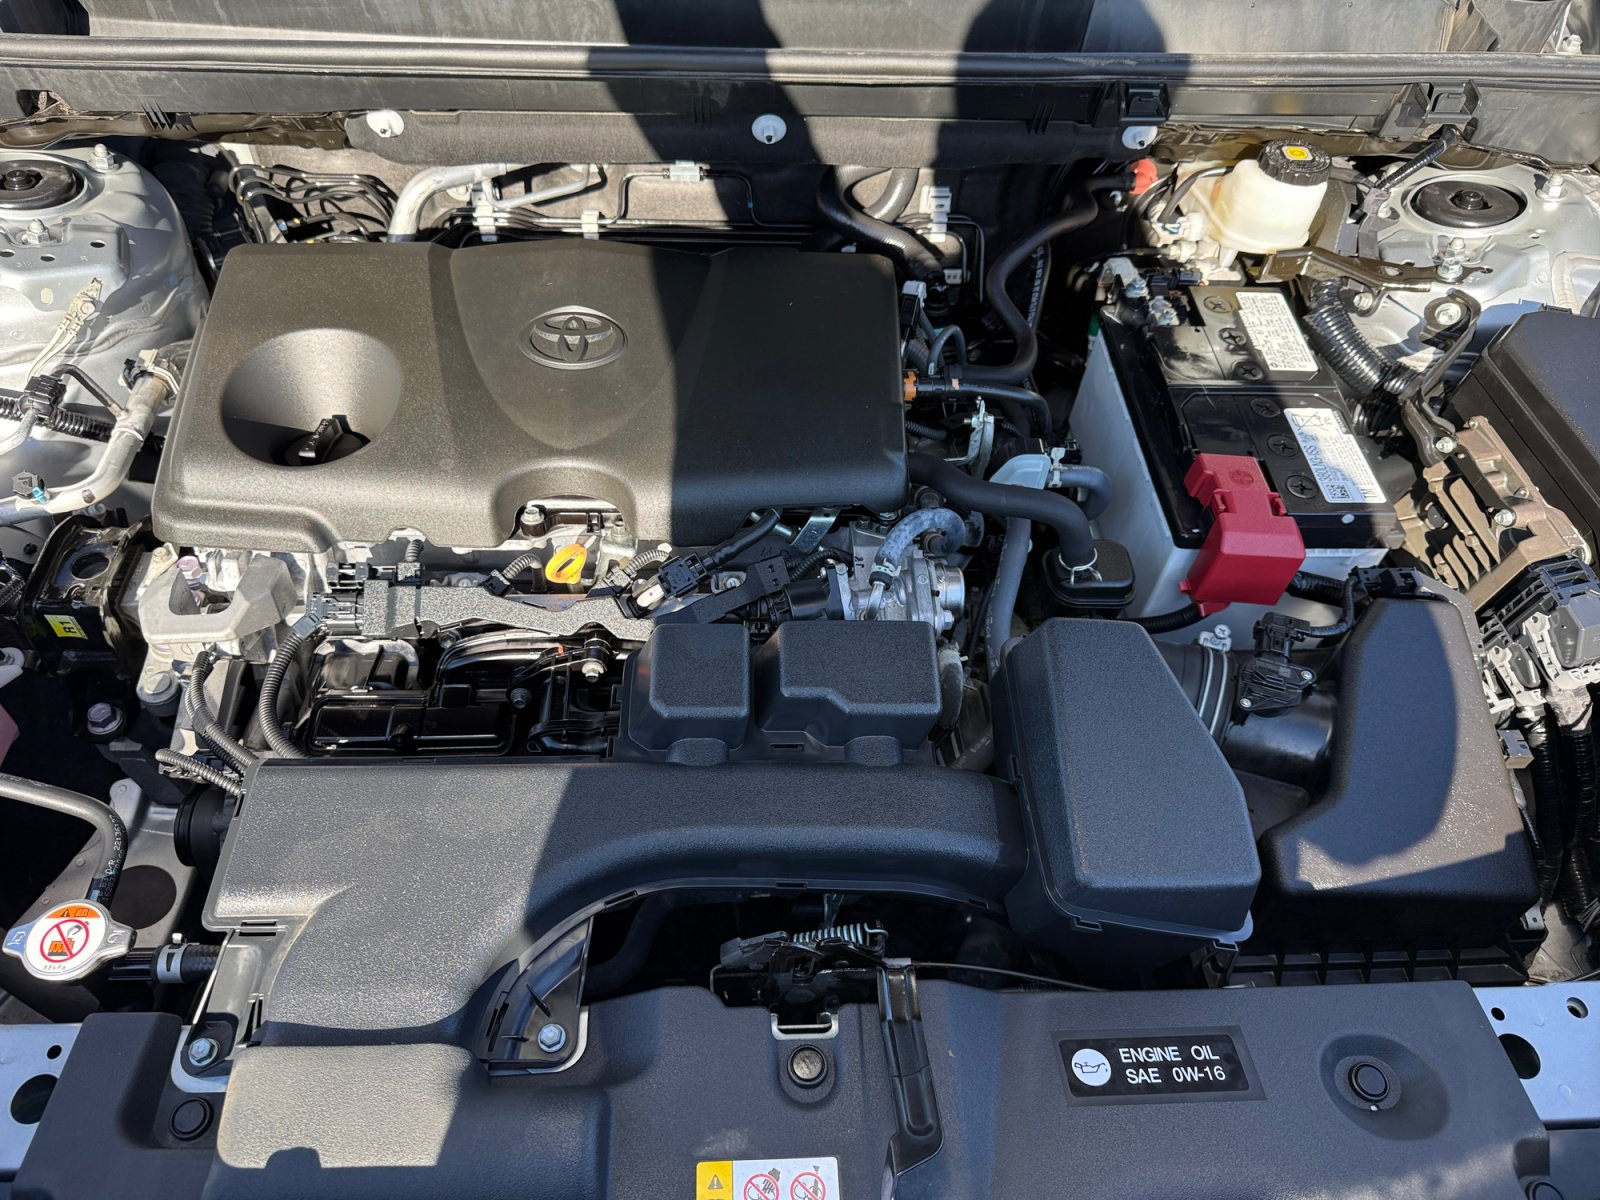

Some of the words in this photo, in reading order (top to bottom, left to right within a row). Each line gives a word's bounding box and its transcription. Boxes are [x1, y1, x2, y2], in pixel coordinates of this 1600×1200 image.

[1118, 1046, 1182, 1063] ENGINE
[1190, 1045, 1220, 1061] OIL
[1125, 1068, 1162, 1084] SAE
[1172, 1065, 1226, 1082] 0W-16
